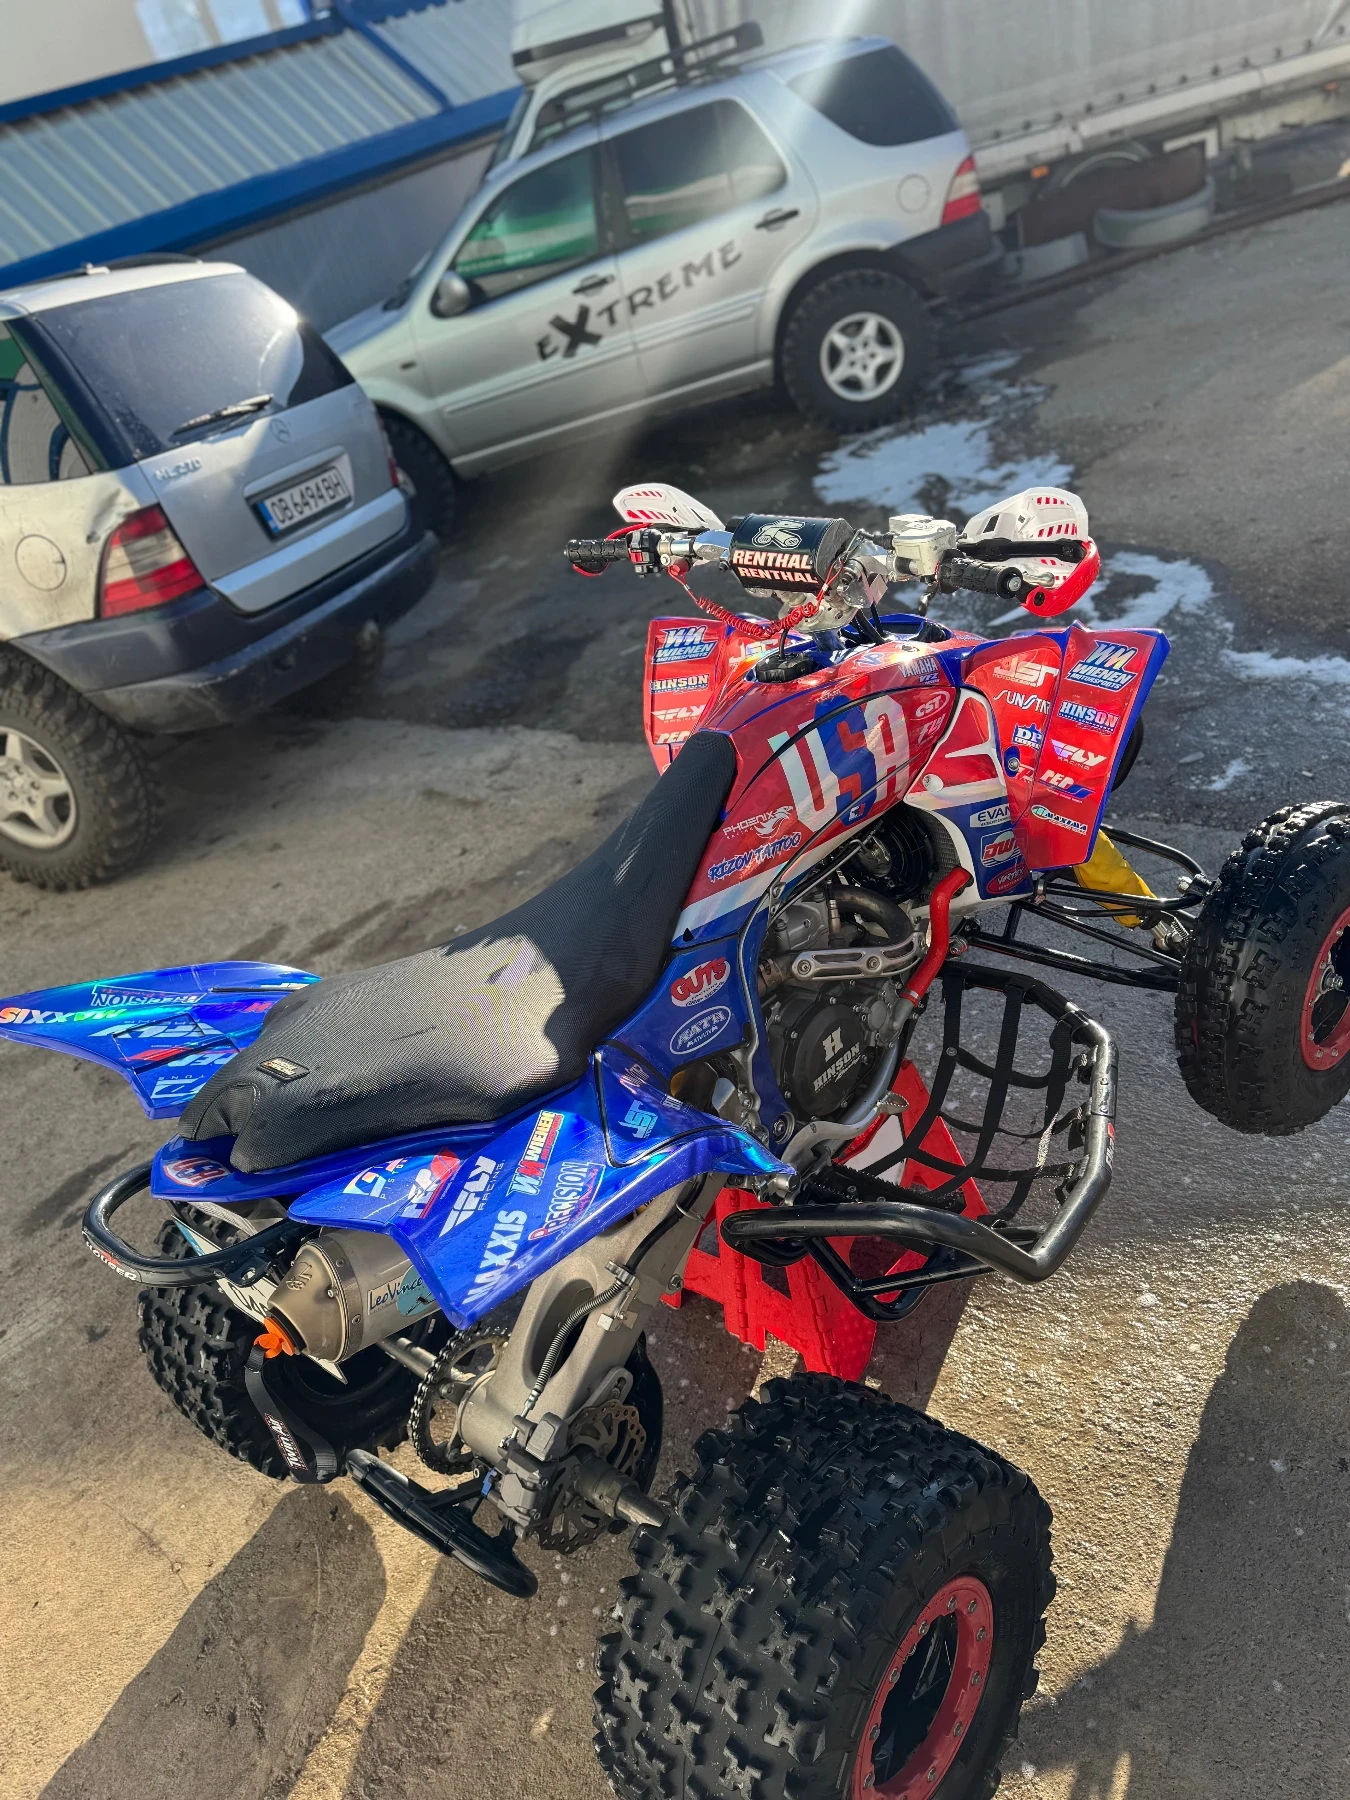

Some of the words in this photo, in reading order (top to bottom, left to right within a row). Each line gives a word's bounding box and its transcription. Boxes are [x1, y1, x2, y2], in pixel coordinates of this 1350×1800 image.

[535, 239, 742, 361] EXTREME
[732, 549, 812, 570] RENTHAL
[737, 566, 819, 584] RENTHAL
[655, 642, 714, 658] WIENEN
[898, 657, 939, 678] YAMAHA
[1071, 663, 1132, 684] WIENEN
[652, 674, 709, 690] HINSON
[1069, 672, 1122, 689] MOTORSPORTS
[915, 695, 943, 717] CST
[1060, 701, 1119, 727] HINSON
[767, 694, 910, 832] USA
[1051, 739, 1107, 766] FLY
[722, 811, 775, 836] PHOENIX
[1045, 812, 1088, 831] MAXIMA
[753, 832, 802, 864] TATTOO
[670, 956, 727, 1002] GUTS
[0, 1006, 127, 1025] MAXXIS
[822, 1026, 844, 1062] H
[813, 1042, 860, 1092] HINSON
[523, 1111, 556, 1162] WIENEN
[477, 1162, 504, 1211] RACING
[462, 1209, 528, 1305] MAXXIS
